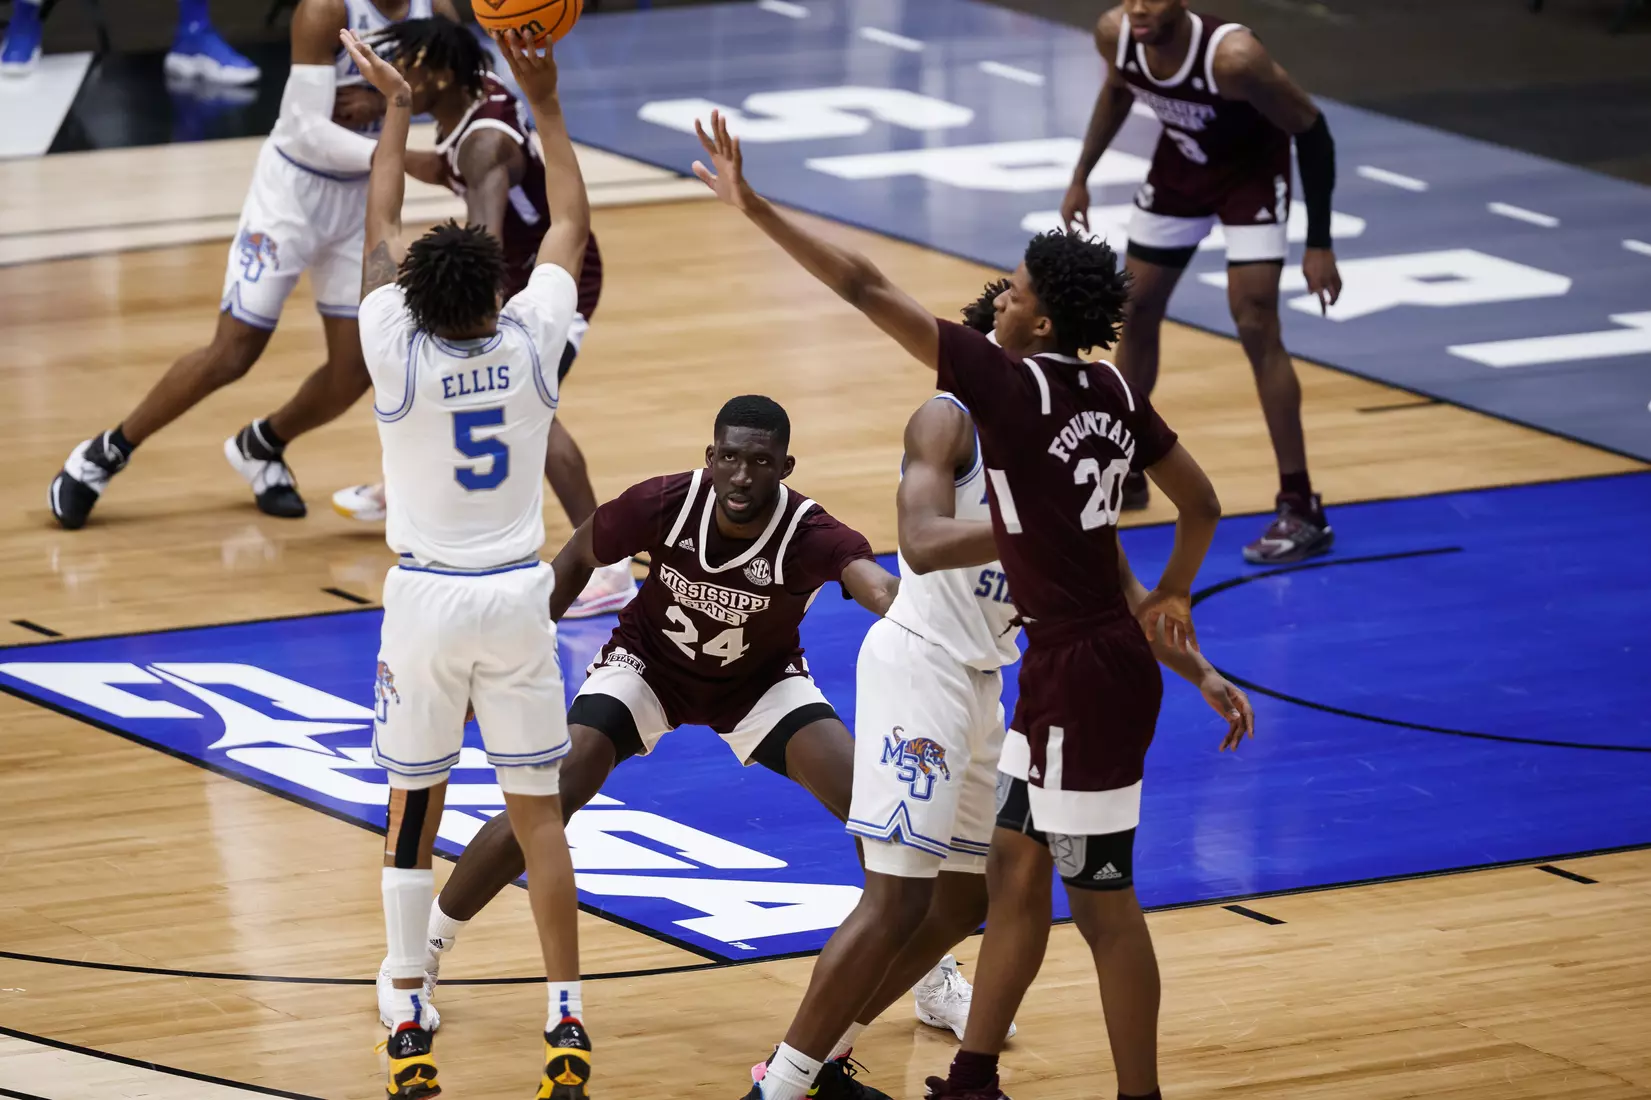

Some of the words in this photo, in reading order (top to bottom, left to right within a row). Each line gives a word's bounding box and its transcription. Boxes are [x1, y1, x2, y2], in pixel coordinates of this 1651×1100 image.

[442, 365, 510, 399] ELLIS
[452, 406, 510, 492] 5
[1073, 457, 1130, 531] 20
[660, 566, 771, 611] MISSISSIPPI
[751, 559, 769, 579] SEC
[684, 599, 735, 625] STATE
[661, 605, 750, 668] 24
[611, 653, 639, 669] STATE
[880, 734, 937, 802] MSU
